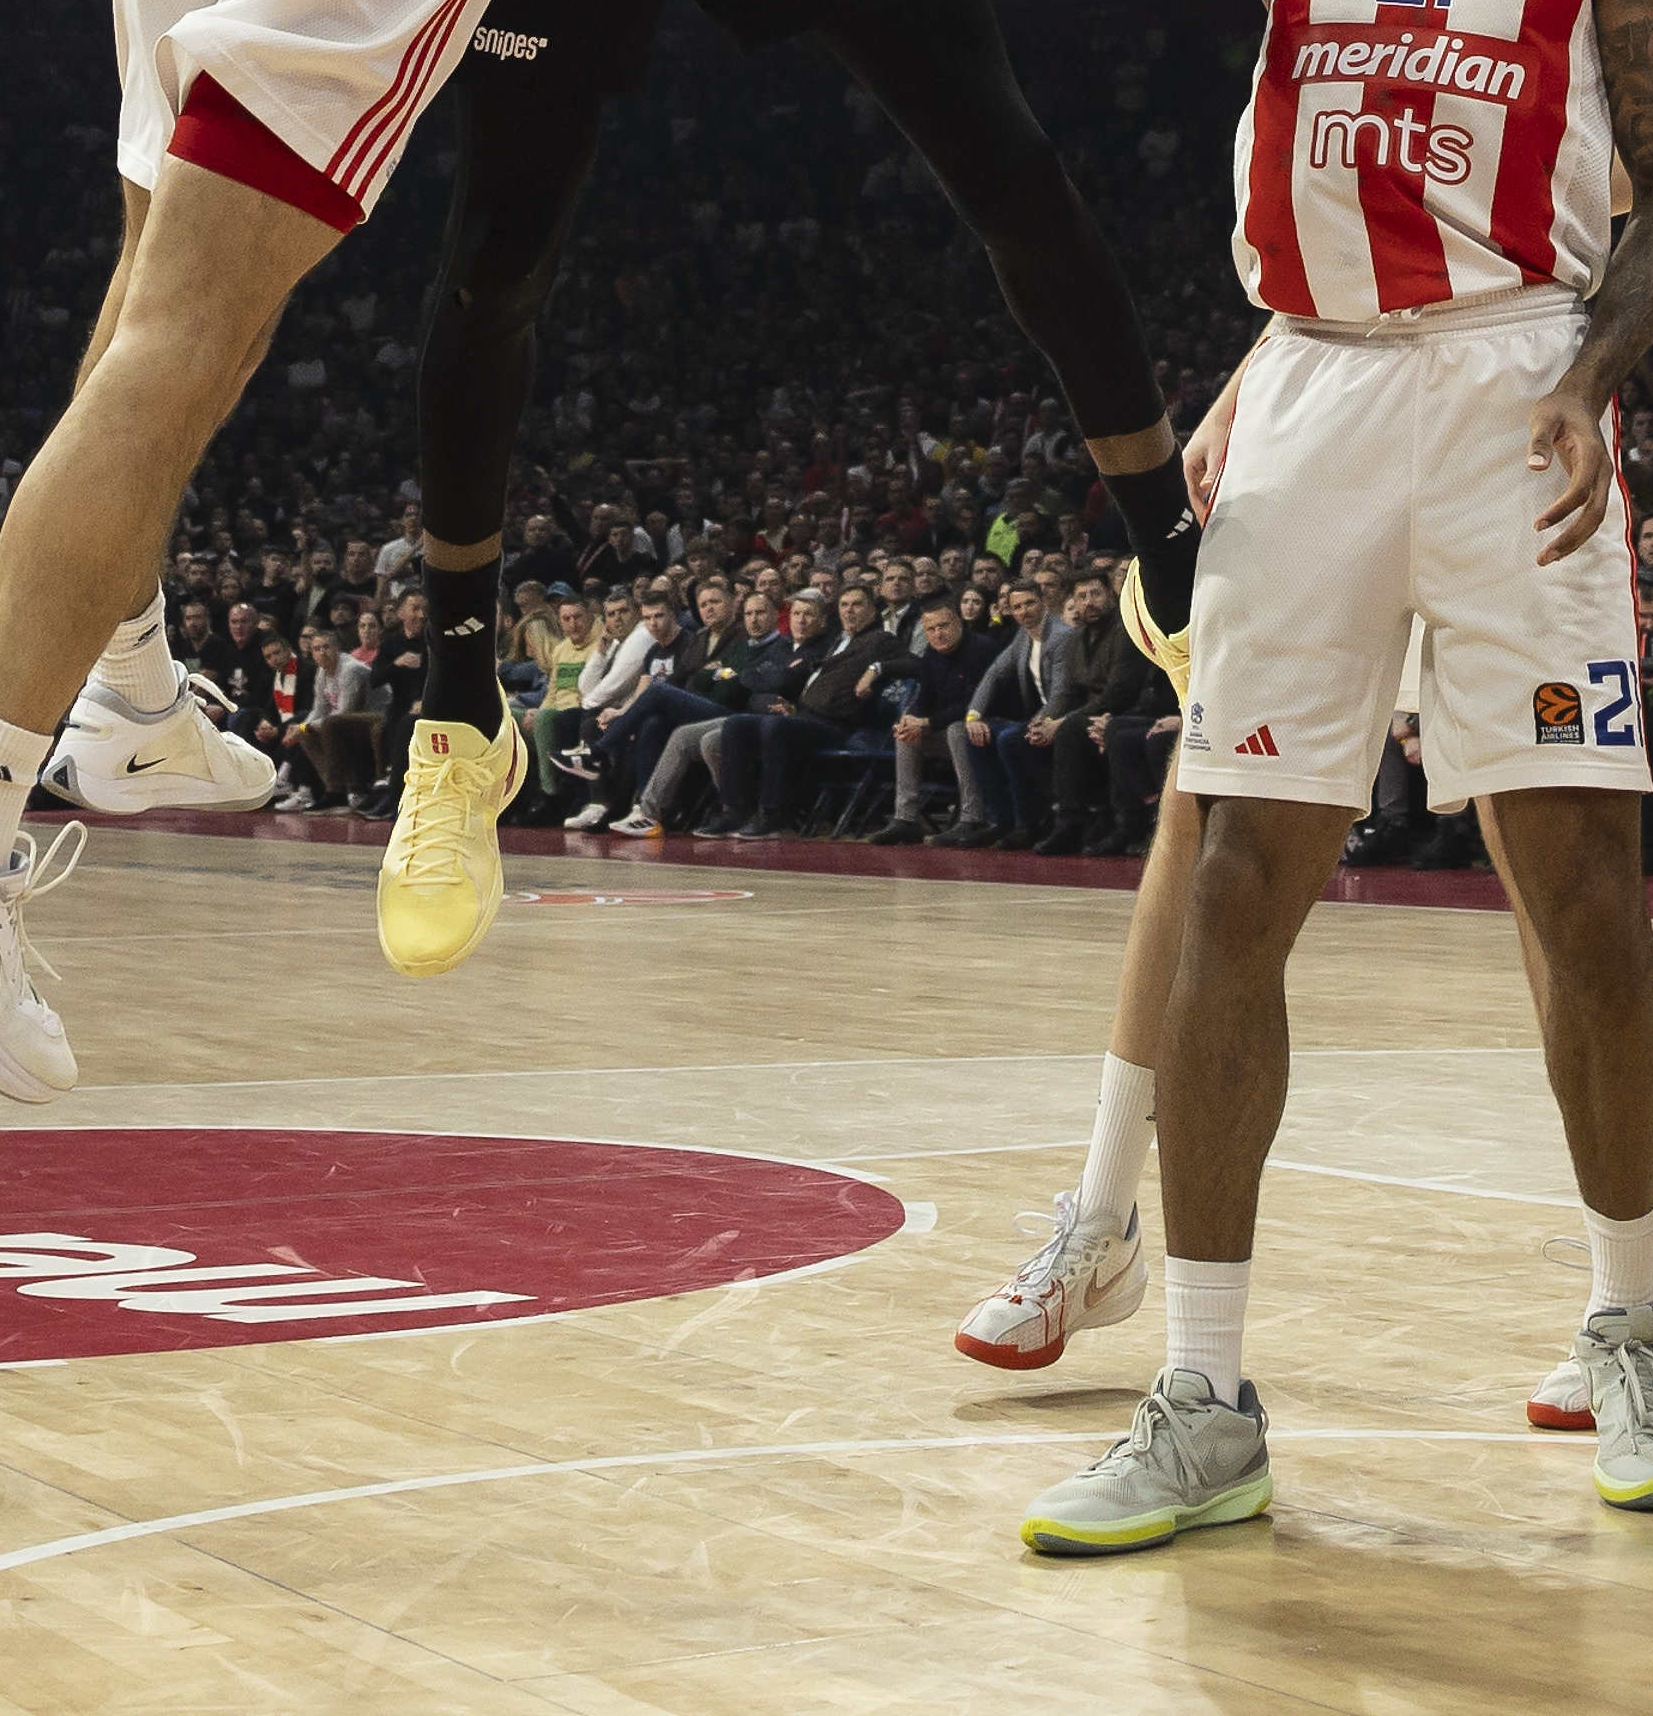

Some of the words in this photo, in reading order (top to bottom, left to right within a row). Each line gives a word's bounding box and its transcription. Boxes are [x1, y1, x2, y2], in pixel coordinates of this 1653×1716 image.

[473, 26, 540, 61] snipes
[1290, 32, 1527, 101] meridian
[1309, 106, 1474, 186] mts
[1586, 659, 1644, 749] 2
